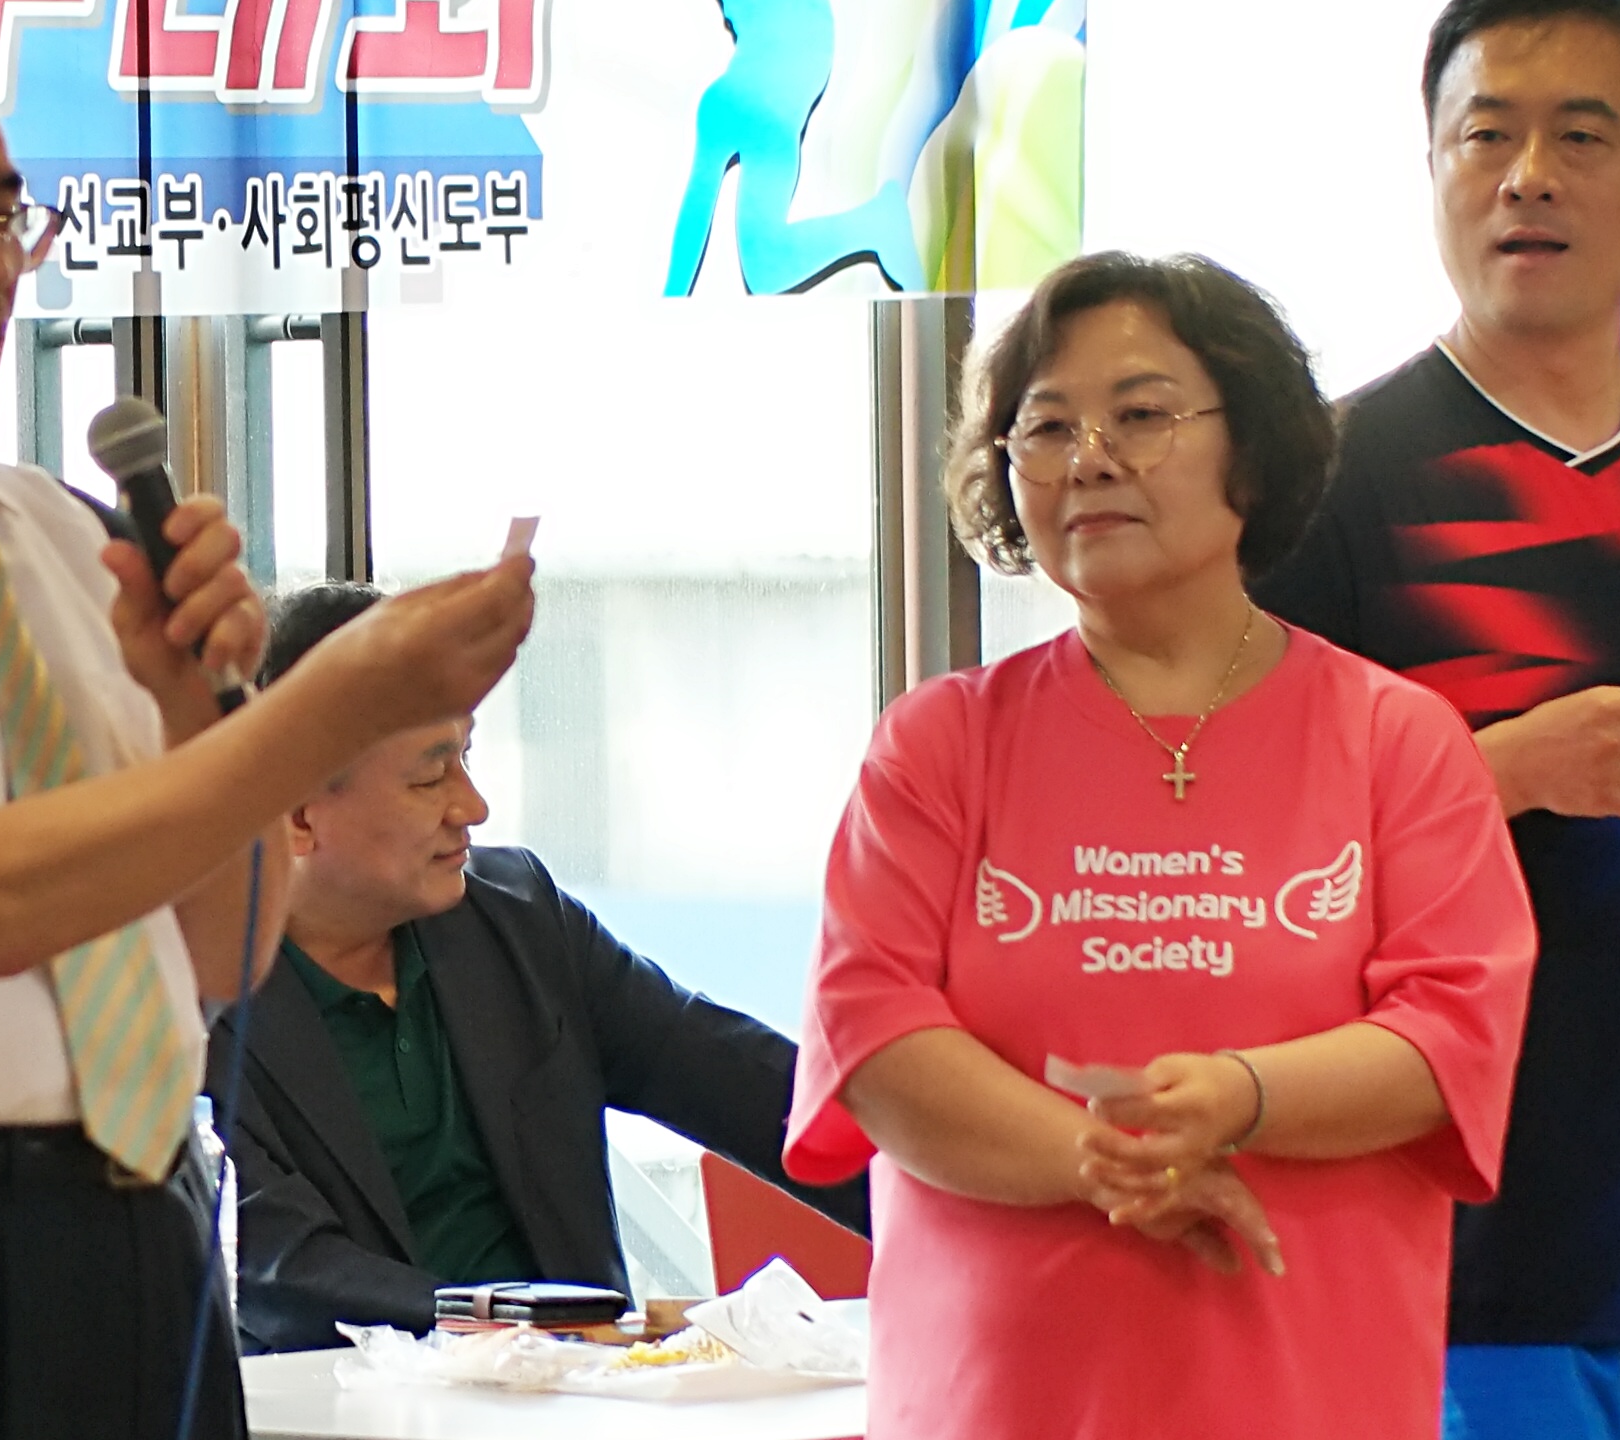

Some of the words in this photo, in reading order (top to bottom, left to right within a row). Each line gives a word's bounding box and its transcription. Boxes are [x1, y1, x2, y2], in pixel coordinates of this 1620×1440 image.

[1073, 844, 1245, 877] Women's
[1050, 888, 1268, 928] Missionary
[1081, 935, 1235, 977] Society
